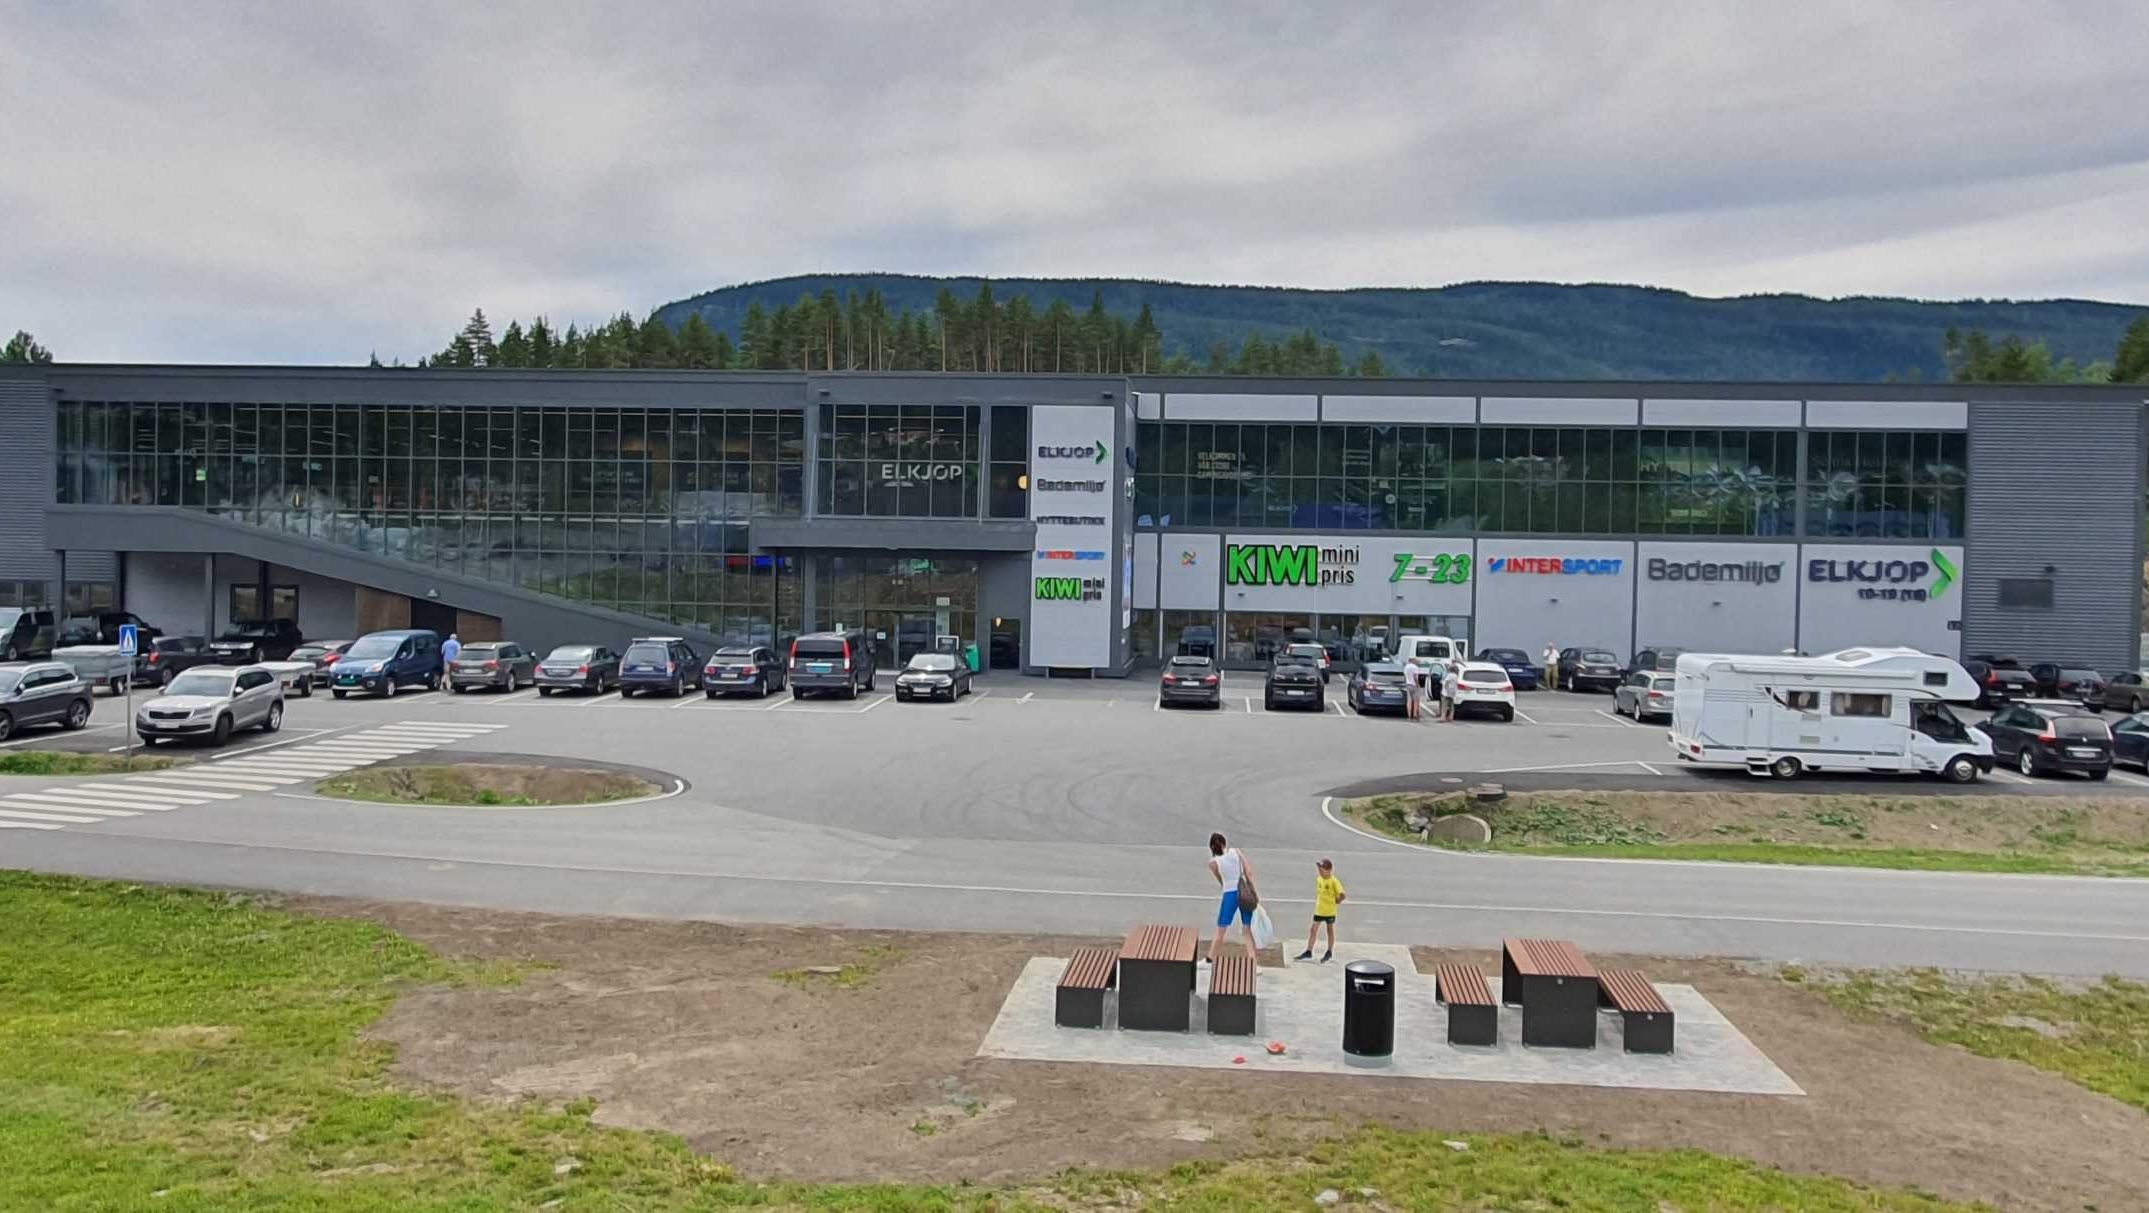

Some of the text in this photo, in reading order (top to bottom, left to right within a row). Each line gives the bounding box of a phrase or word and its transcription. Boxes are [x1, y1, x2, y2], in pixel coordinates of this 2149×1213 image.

[1322, 545, 1360, 563] mini
[1226, 545, 1319, 586] KIWI
[1506, 557, 1622, 575] INTERSPORT
[1083, 577, 1105, 589] mini
[1322, 567, 1355, 588] pris
[1035, 577, 1082, 600] KIWI
[1083, 589, 1102, 603] pris
